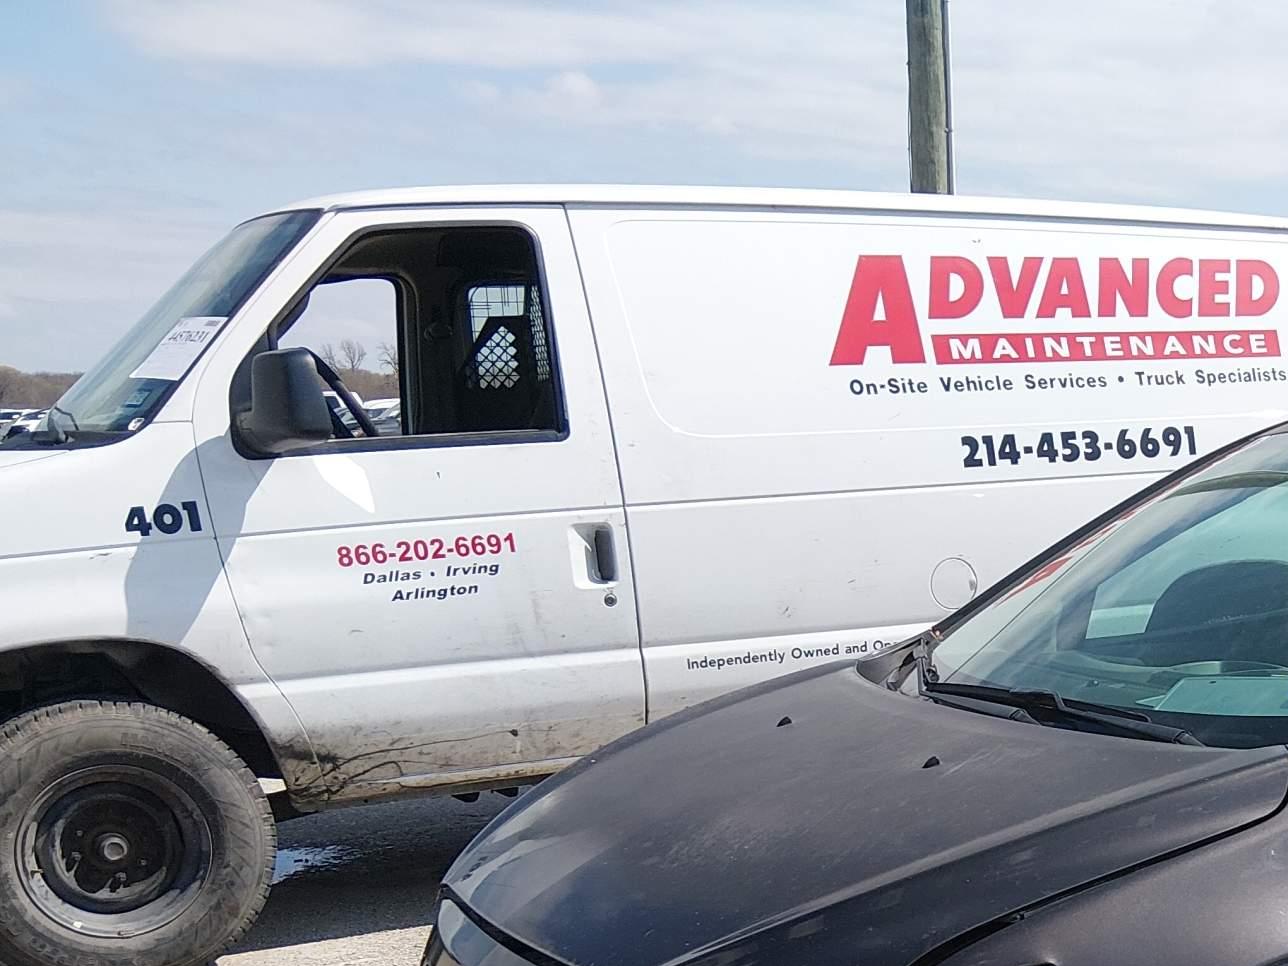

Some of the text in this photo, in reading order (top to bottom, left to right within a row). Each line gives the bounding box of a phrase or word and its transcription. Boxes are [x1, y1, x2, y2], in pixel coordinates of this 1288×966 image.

[830, 255, 1280, 366] ADVANCED
[949, 333, 1268, 360] MAINTENANCE
[850, 366, 1288, 396] On-Site Vehicle Services Truck Specialists
[961, 425, 1198, 468] 214-453-6691
[124, 500, 203, 537] 401
[337, 532, 517, 568] 866-202-6691
[362, 562, 500, 585] Dallas Irving
[391, 583, 479, 603] Arlington
[687, 648, 785, 670] Independently
[791, 643, 840, 660] Owned
[845, 640, 868, 654] and
